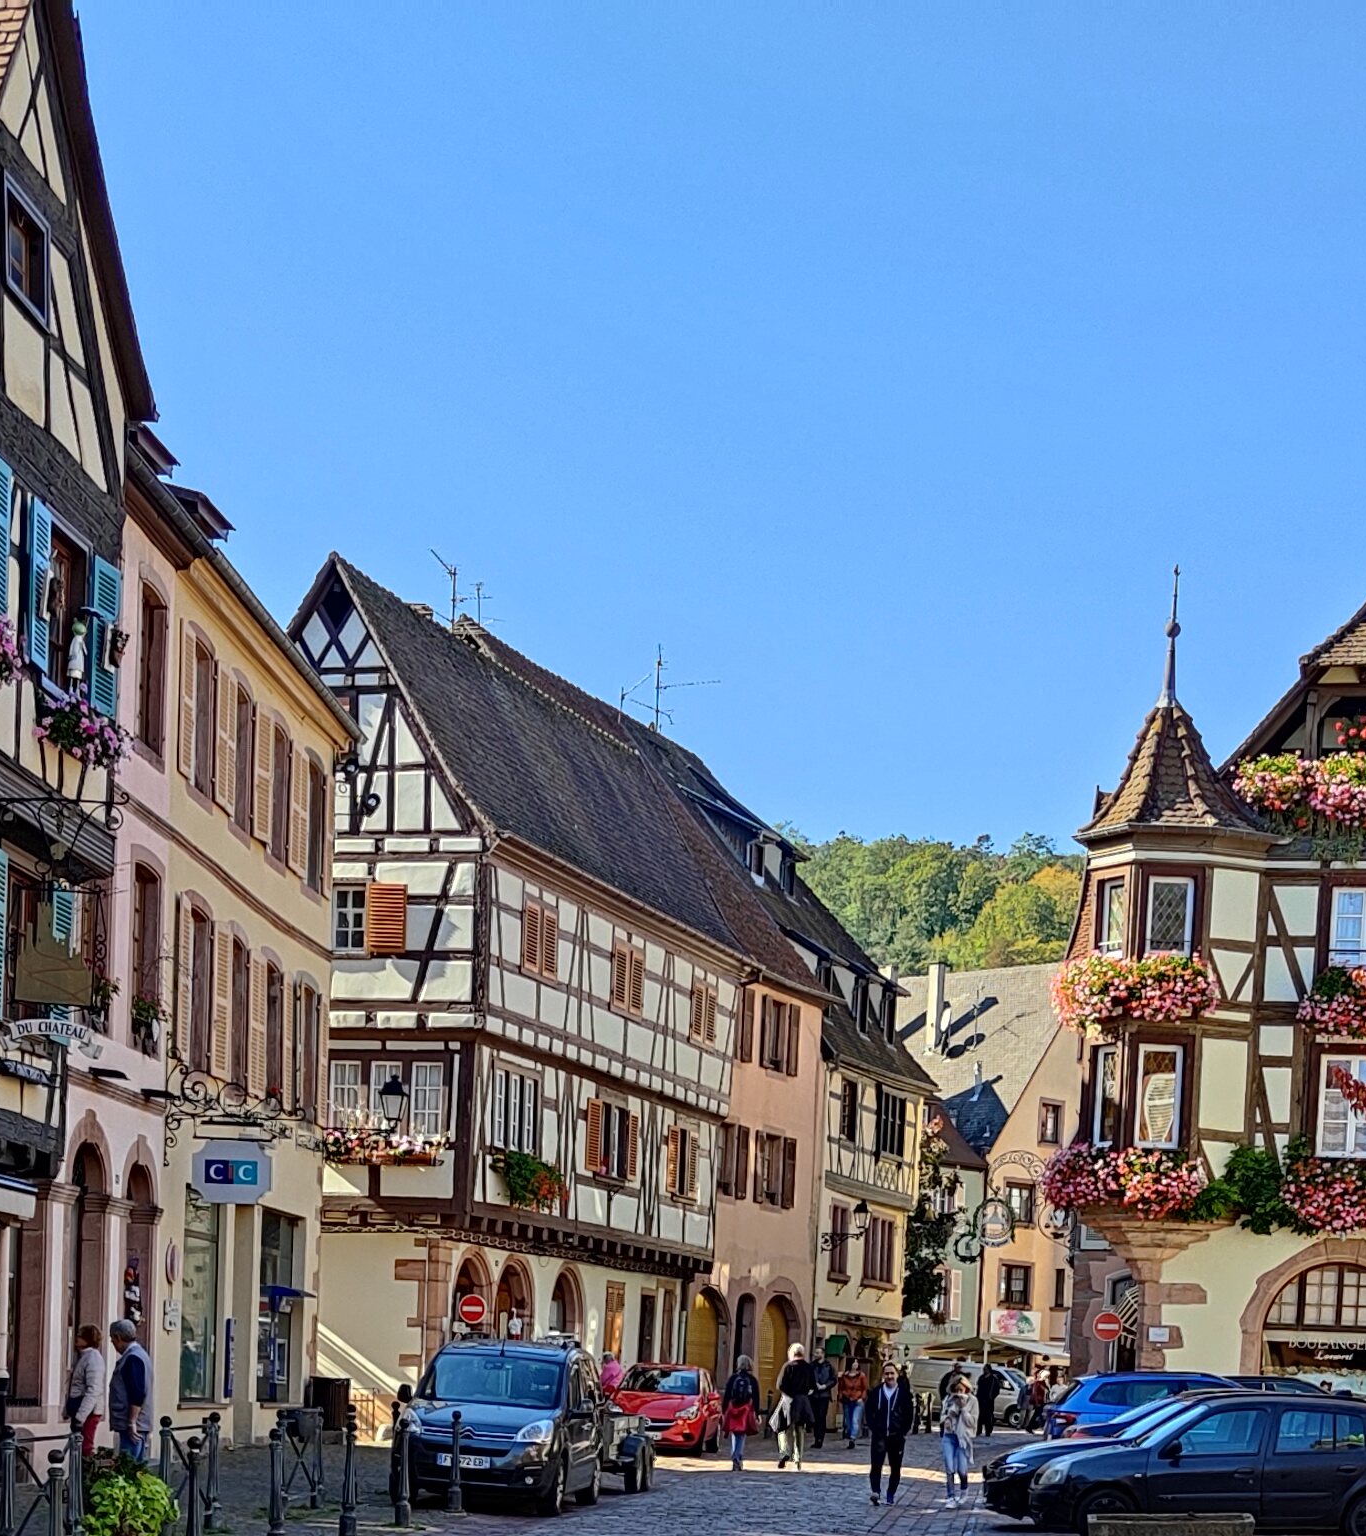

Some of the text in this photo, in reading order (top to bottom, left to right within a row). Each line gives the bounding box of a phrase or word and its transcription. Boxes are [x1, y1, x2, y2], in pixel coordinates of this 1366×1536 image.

[17, 1021, 86, 1040] DU CHATEAU
[209, 1164, 253, 1181] CIC
